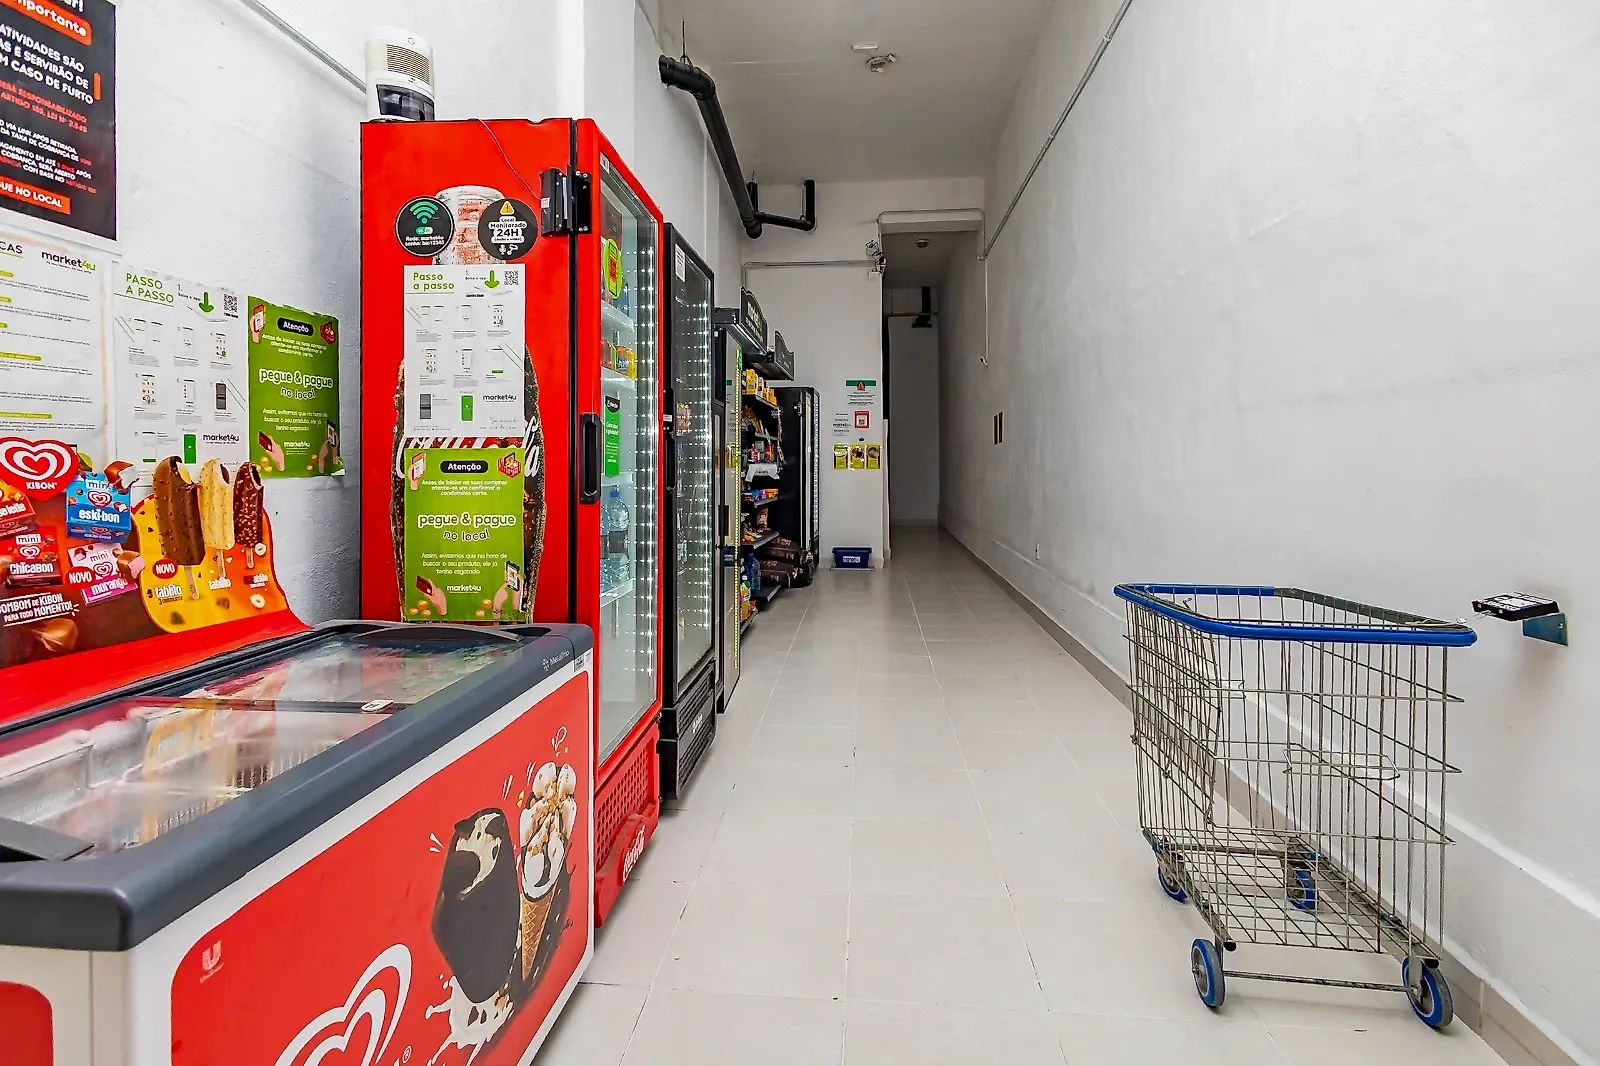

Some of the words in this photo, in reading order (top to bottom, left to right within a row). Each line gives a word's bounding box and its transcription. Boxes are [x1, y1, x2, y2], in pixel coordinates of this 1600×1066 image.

[0, 24, 61, 60] ATIVIDADES
[62, 55, 84, 72] SÃO
[14, 45, 22, 57] E
[24, 50, 73, 80] SERVIRÃO
[76, 76, 88, 89] DE
[10, 61, 43, 82] CASO
[46, 75, 60, 90] DE
[62, 83, 94, 104] FURTO
[6, 122, 16, 130] VIA
[12, 132, 28, 142] TAXA
[16, 186, 31, 197] NO
[33, 192, 62, 208] LOCAL
[496, 228, 519, 237] 24H
[41, 251, 96, 271] market4u
[126, 272, 163, 289] PASSO
[413, 272, 443, 280] Passo
[424, 283, 455, 291] passo
[126, 285, 133, 294] A
[138, 286, 174, 303] PASSO
[282, 320, 309, 332] Atenção
[260, 368, 293, 384] pegue
[293, 371, 302, 384] &
[303, 374, 333, 389] pague
[280, 387, 292, 397] no
[295, 388, 316, 400] local
[203, 434, 240, 442] market4u
[448, 463, 482, 472] Atenção
[79, 509, 120, 523] eski-bon
[418, 514, 458, 528] pegue
[461, 512, 471, 525] &
[474, 514, 516, 528] pague
[443, 530, 458, 541] no
[462, 528, 490, 541] local
[90, 551, 108, 562] mini
[155, 563, 175, 574] NOVO
[69, 571, 92, 584] NOVO
[155, 585, 182, 598] tablito
[40, 593, 63, 605] KIBON
[4, 611, 19, 622] PARA
[34, 601, 73, 617] MOMENTO!
